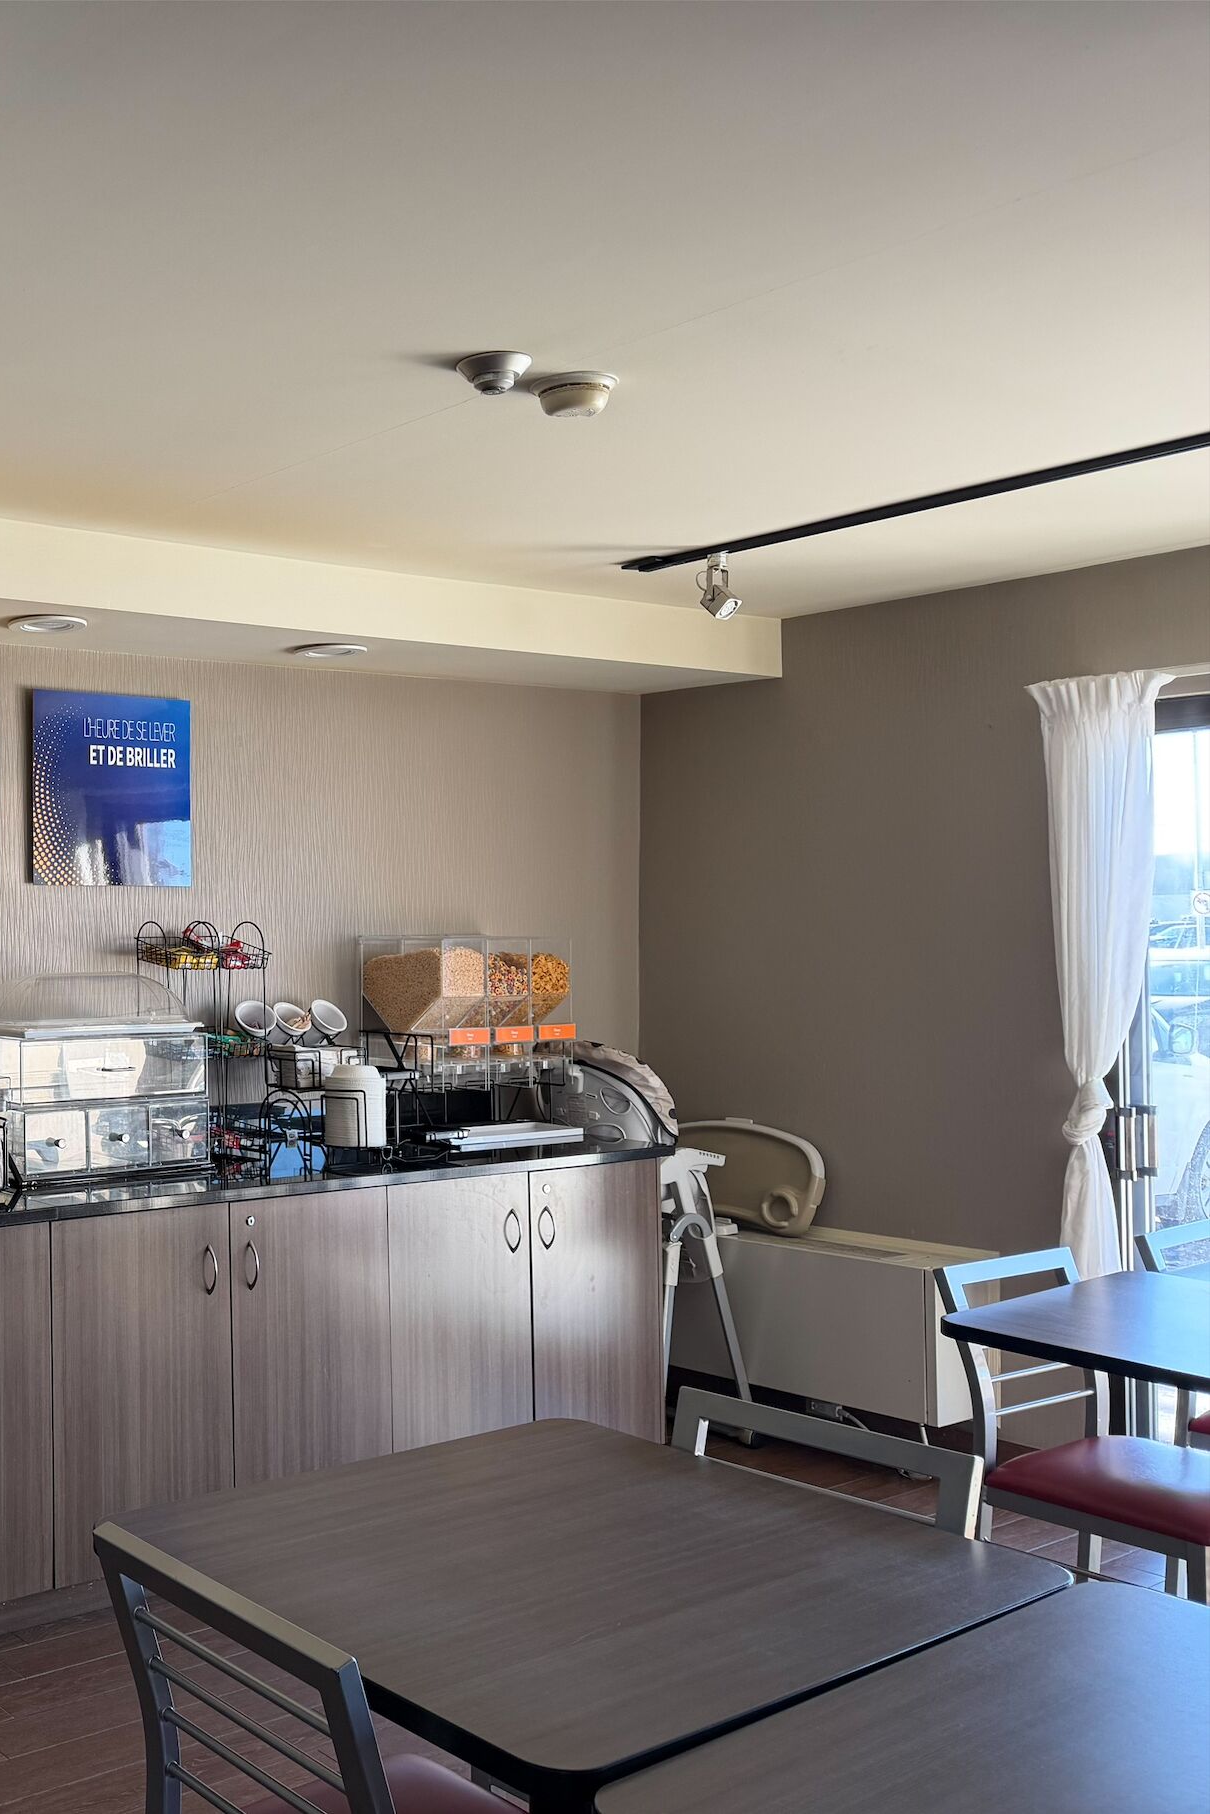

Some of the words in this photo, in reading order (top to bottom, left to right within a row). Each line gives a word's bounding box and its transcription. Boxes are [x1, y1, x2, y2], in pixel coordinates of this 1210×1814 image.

[83, 717, 120, 740] L'HEURE
[122, 720, 135, 740] DE
[136, 720, 147, 741] SE
[149, 722, 176, 742] LEVER
[89, 744, 106, 765] ET
[107, 745, 124, 766] DE
[126, 746, 176, 769] BRILLER
